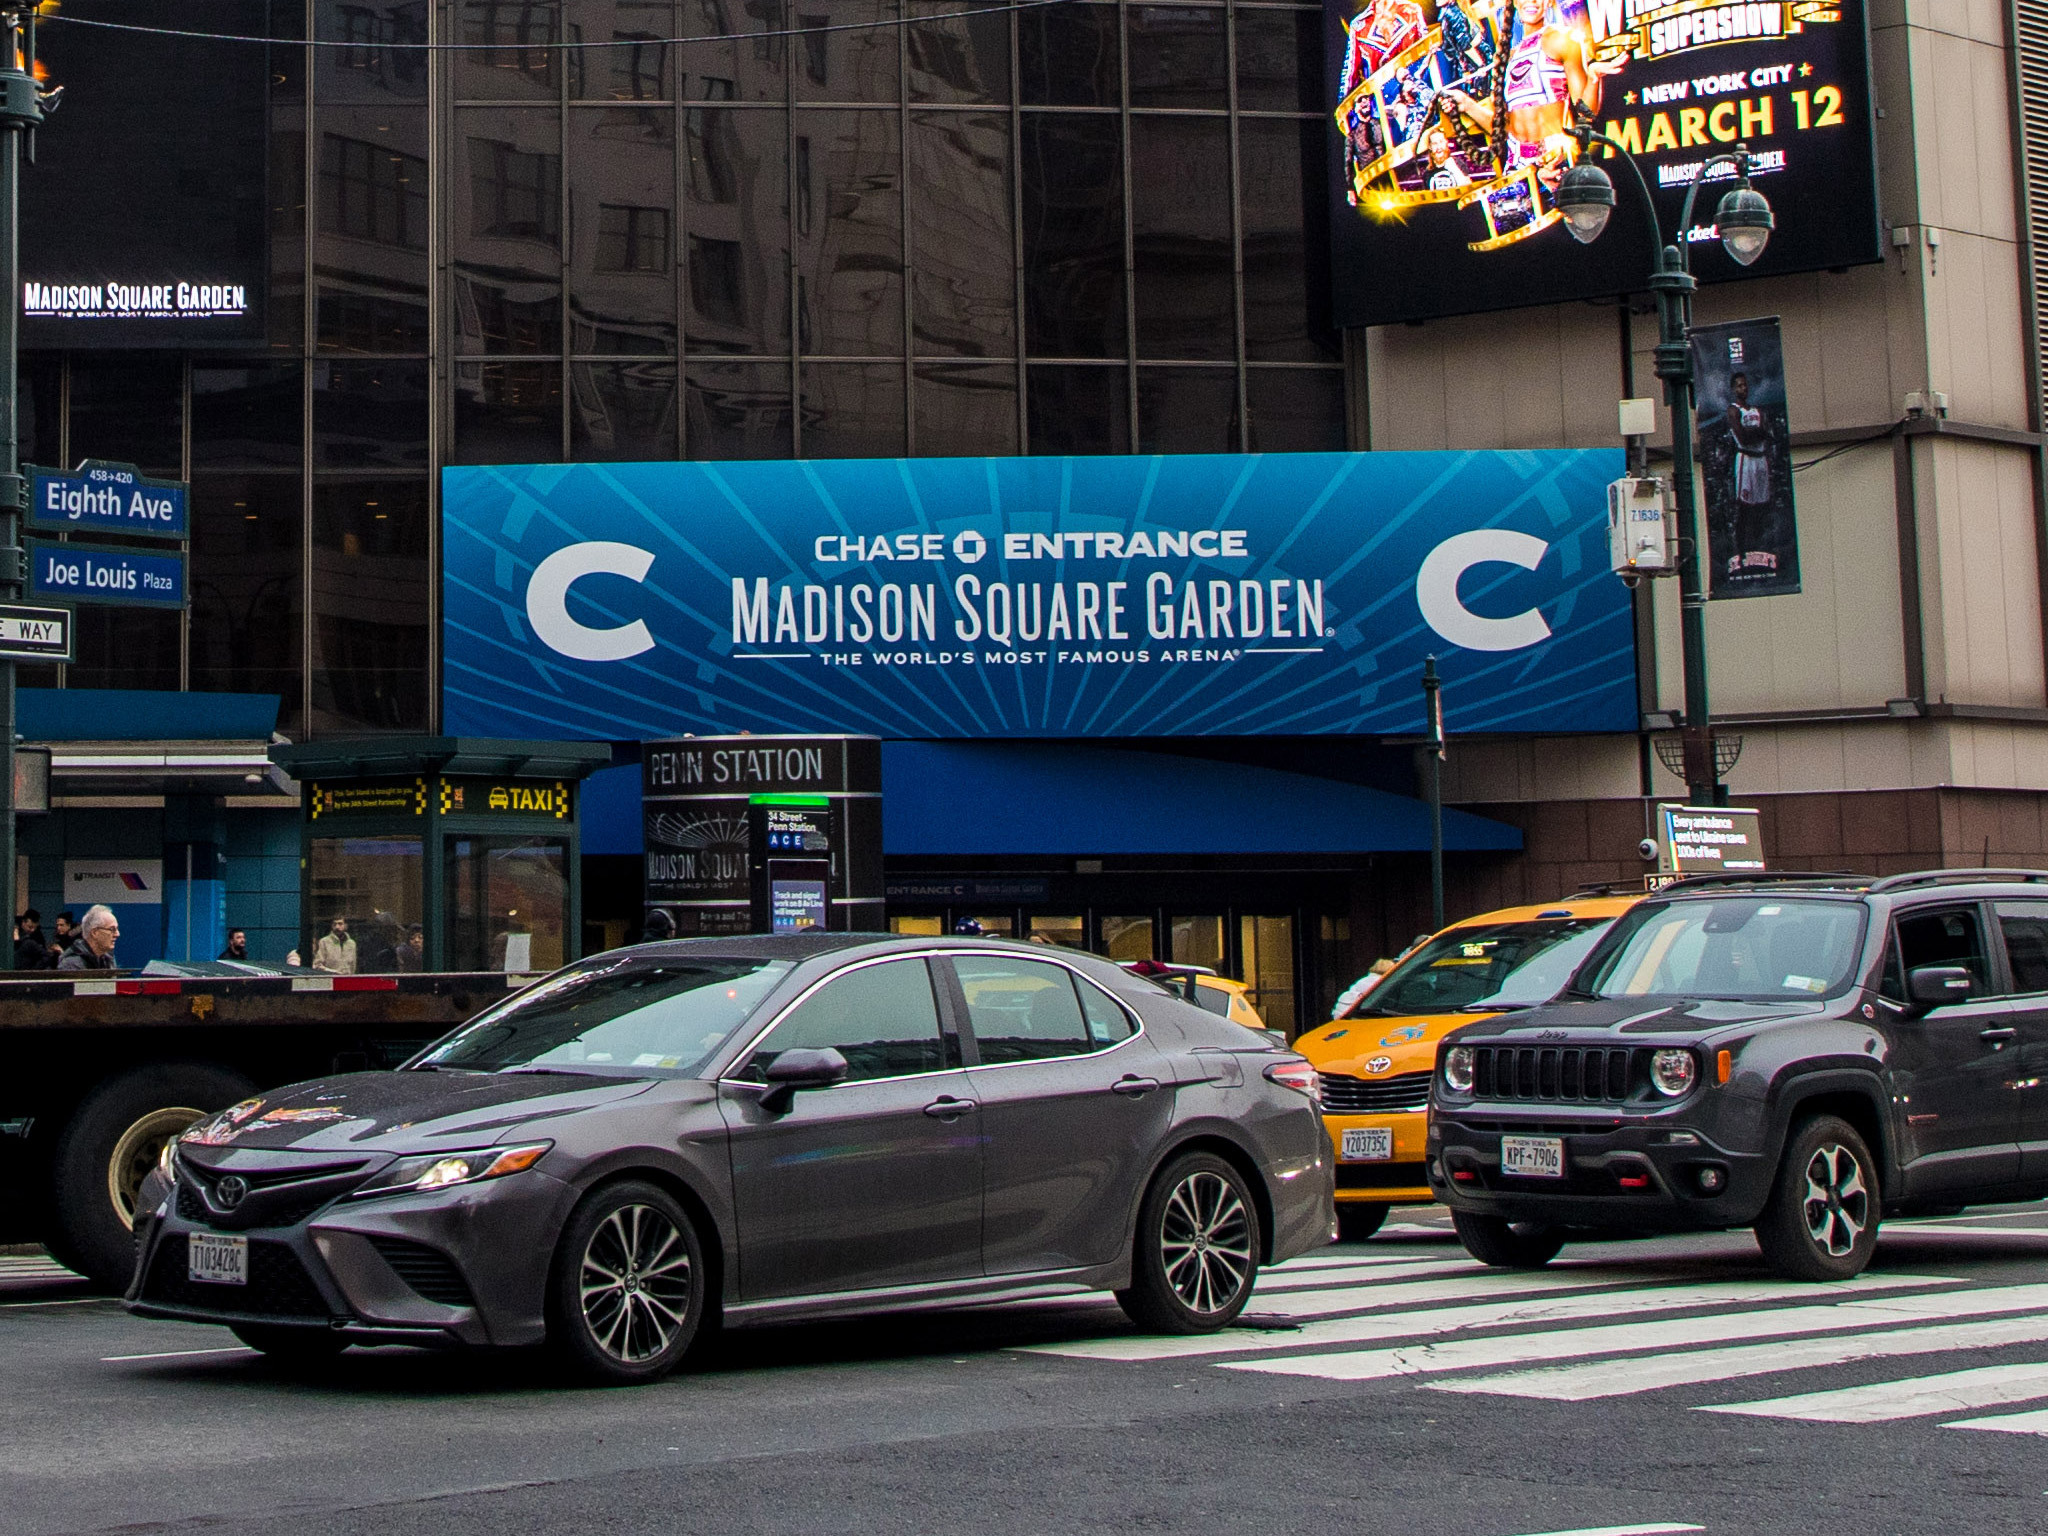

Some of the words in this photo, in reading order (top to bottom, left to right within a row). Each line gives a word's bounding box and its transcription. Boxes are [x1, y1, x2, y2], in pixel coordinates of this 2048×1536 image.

[1650, 2, 1781, 55] SUPERSHOW
[1642, 81, 1689, 105] NEW
[1691, 72, 1747, 95] YORK
[1750, 64, 1794, 87] CITY
[1603, 96, 1774, 159] MARCH
[1791, 85, 1845, 129] 12
[25, 282, 102, 310] MADISON
[106, 282, 173, 311] SQUARE
[47, 482, 121, 519] Eighth
[128, 491, 173, 521] Ave
[1631, 509, 1660, 522] 71636
[815, 534, 945, 562] CHASE
[1004, 530, 1248, 560] ENTRANCE
[45, 558, 79, 585] Joe
[86, 560, 137, 590] Louis
[143, 572, 172, 590] Plaza
[526, 541, 656, 661] C
[1416, 528, 1552, 651] C
[732, 577, 936, 643] MADISON
[955, 573, 1128, 647] SQUARE
[19, 621, 53, 640] WAY
[820, 653, 862, 665] THE
[873, 652, 975, 665] WORLD'S
[985, 652, 1047, 664] MOST
[1058, 651, 1150, 663] FAMOUS
[651, 751, 702, 785] PENN
[713, 749, 823, 783] STATION
[510, 788, 552, 811] TAXI
[768, 812, 778, 821] 34
[779, 812, 803, 821] Street
[768, 822, 788, 831] Penn
[788, 822, 817, 832] Station
[770, 835, 778, 845] A
[782, 836, 790, 845] C
[794, 836, 801, 845] E
[886, 885, 951, 895] ENTRANCE
[953, 885, 964, 895] C
[1536, 1029, 1568, 1041] Jeep
[1345, 1135, 1387, 1153] Y203735C
[194, 1245, 241, 1273] T103428C
